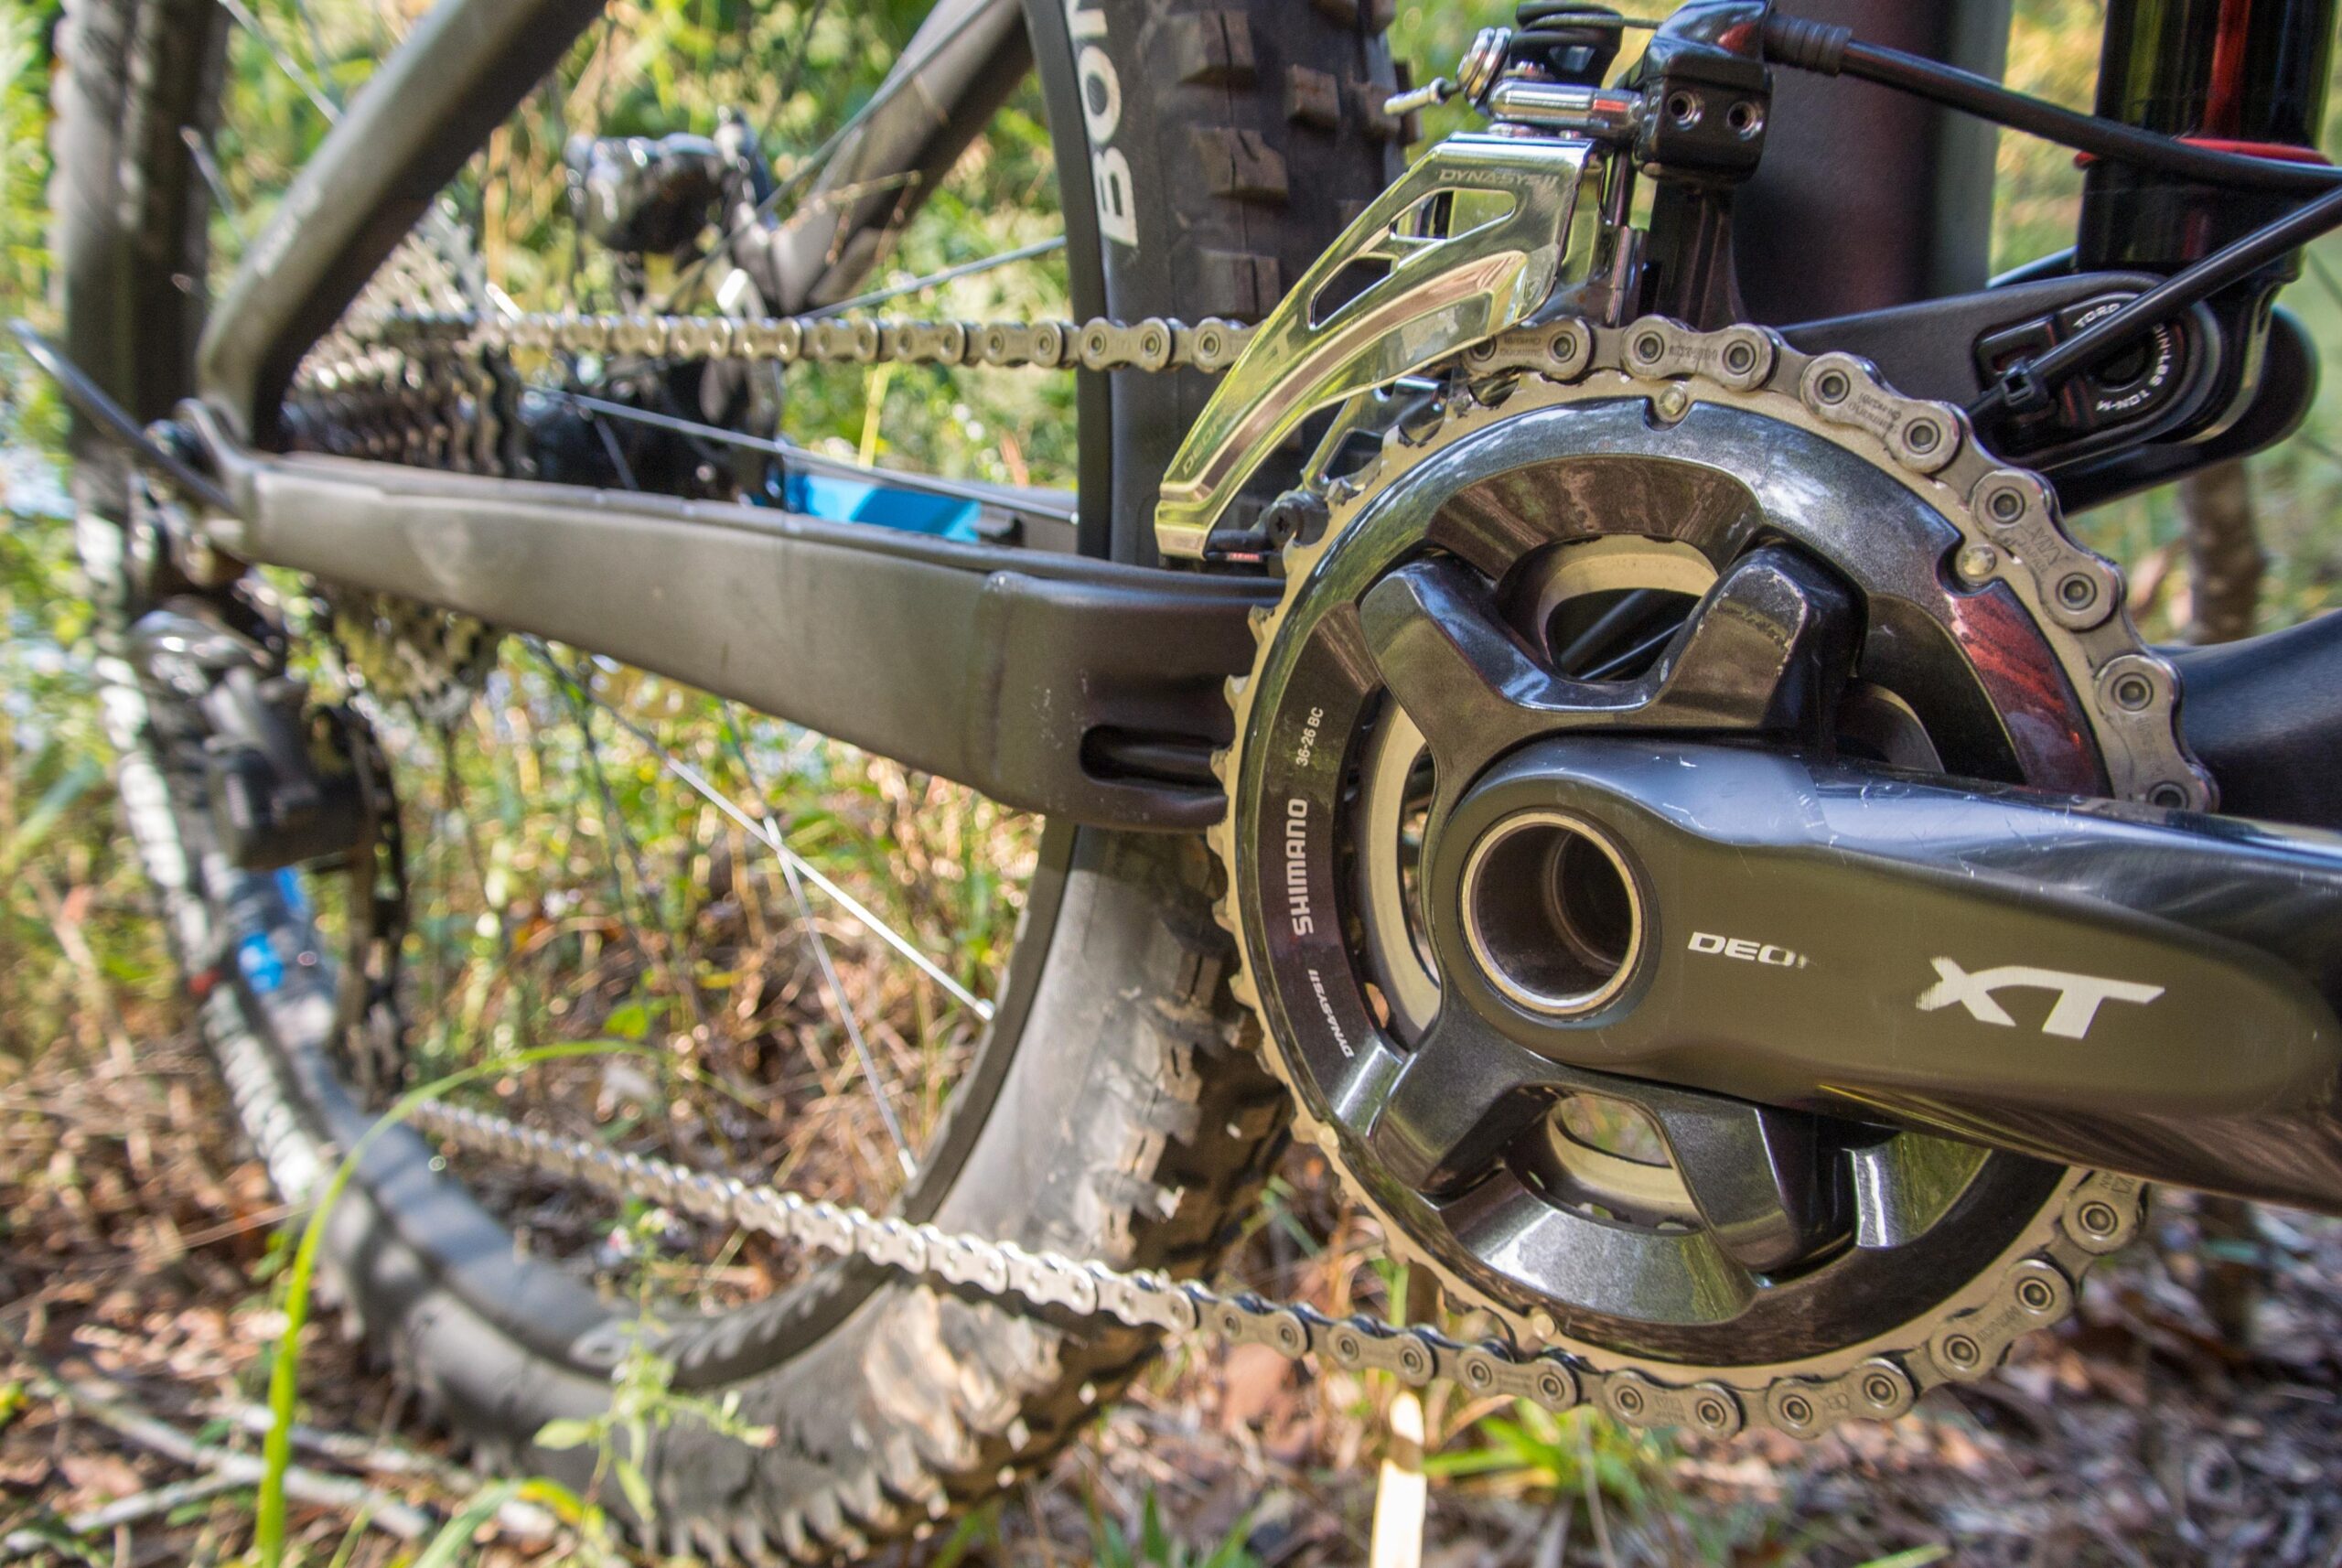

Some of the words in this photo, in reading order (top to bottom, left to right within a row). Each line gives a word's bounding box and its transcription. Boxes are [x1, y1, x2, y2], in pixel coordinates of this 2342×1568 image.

[2073, 303, 2121, 328] TORQ
[1295, 728, 1316, 767] 36-26
[1307, 707, 1324, 727] BC
[1285, 798, 1314, 936] SHIMANO
[1917, 956, 2165, 1039] XT
